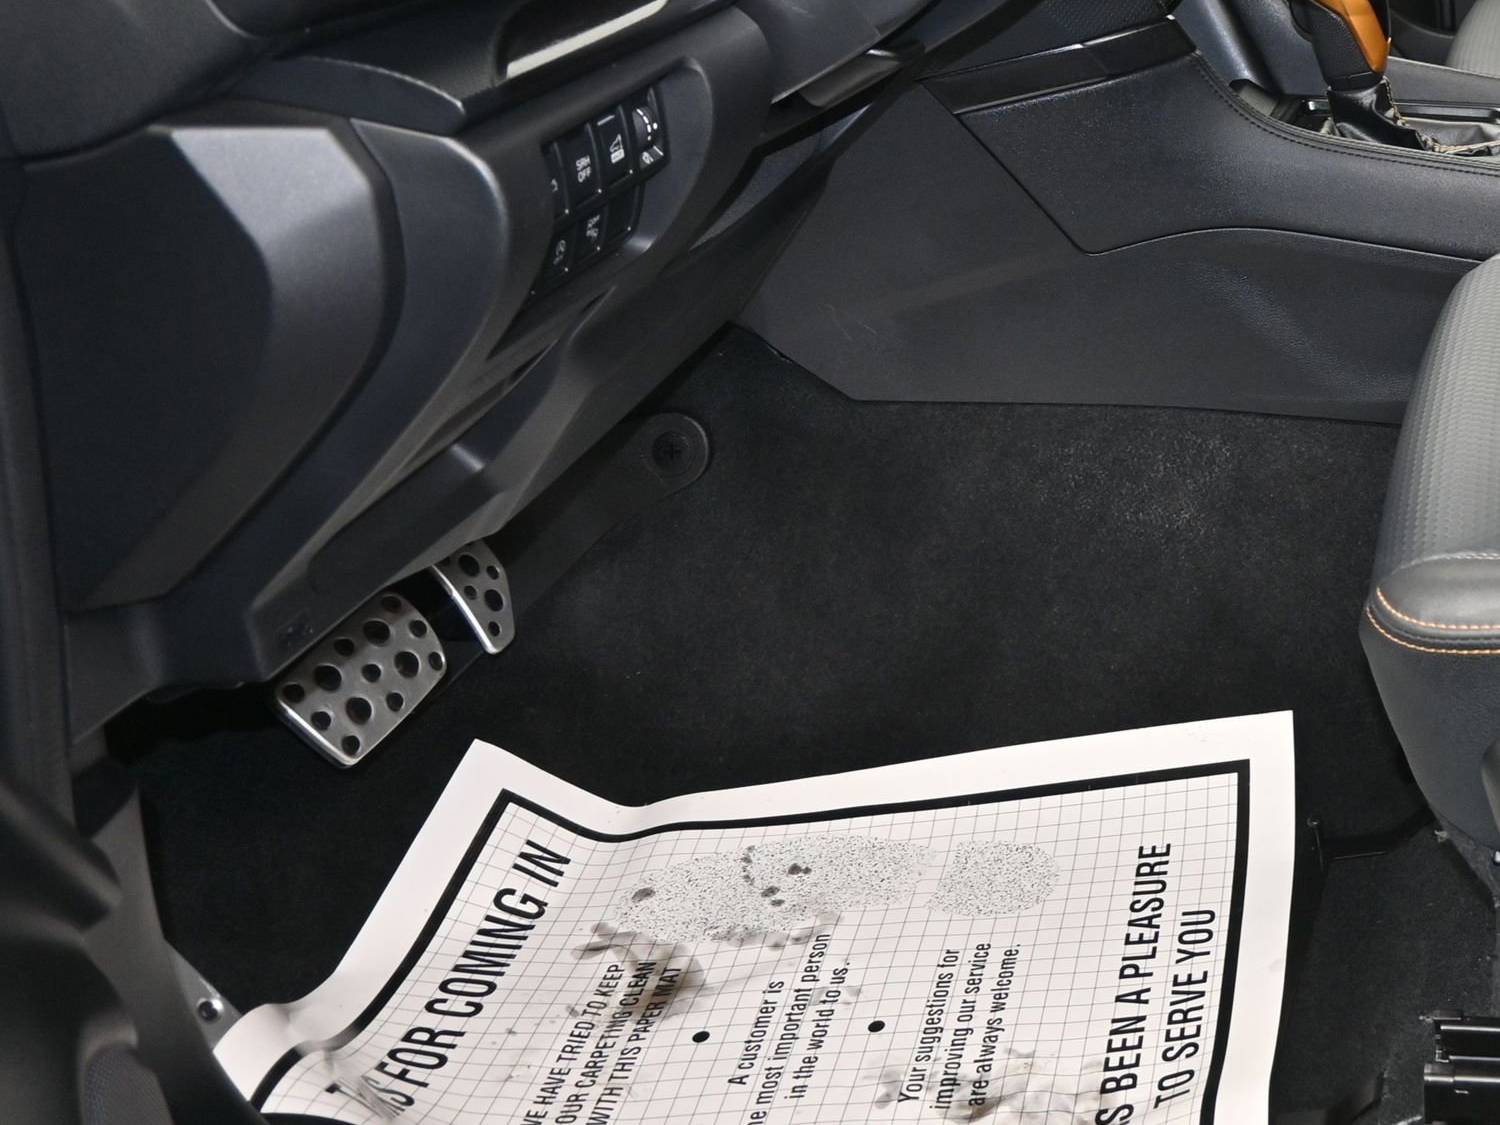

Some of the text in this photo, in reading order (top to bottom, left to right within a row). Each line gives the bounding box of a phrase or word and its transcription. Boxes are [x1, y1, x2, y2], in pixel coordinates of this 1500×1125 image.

[374, 838, 572, 1088] FOR COMING IN
[801, 934, 831, 983] person
[1118, 842, 1172, 980] PLEASURE
[581, 1000, 608, 1017] TO
[593, 963, 626, 997] KEEP
[727, 980, 785, 1086] A customer is
[767, 987, 813, 1061] important
[784, 961, 850, 1100] in the world to us.
[897, 948, 960, 1104] Your suggestions for
[929, 942, 992, 1109] improving our service
[968, 943, 1022, 1107] are always welcome.
[1114, 986, 1152, 1005] A
[1153, 908, 1217, 1110] TO SERVE YOU
[533, 1067, 572, 1106] HAVE
[554, 961, 658, 1125] OUR CARPETING CLEAN
[556, 1020, 596, 1064] TRIED
[585, 966, 683, 1125] WITH THIS PAPER MAT
[755, 1065, 785, 1105] most
[1099, 1014, 1148, 1096] BEEN
